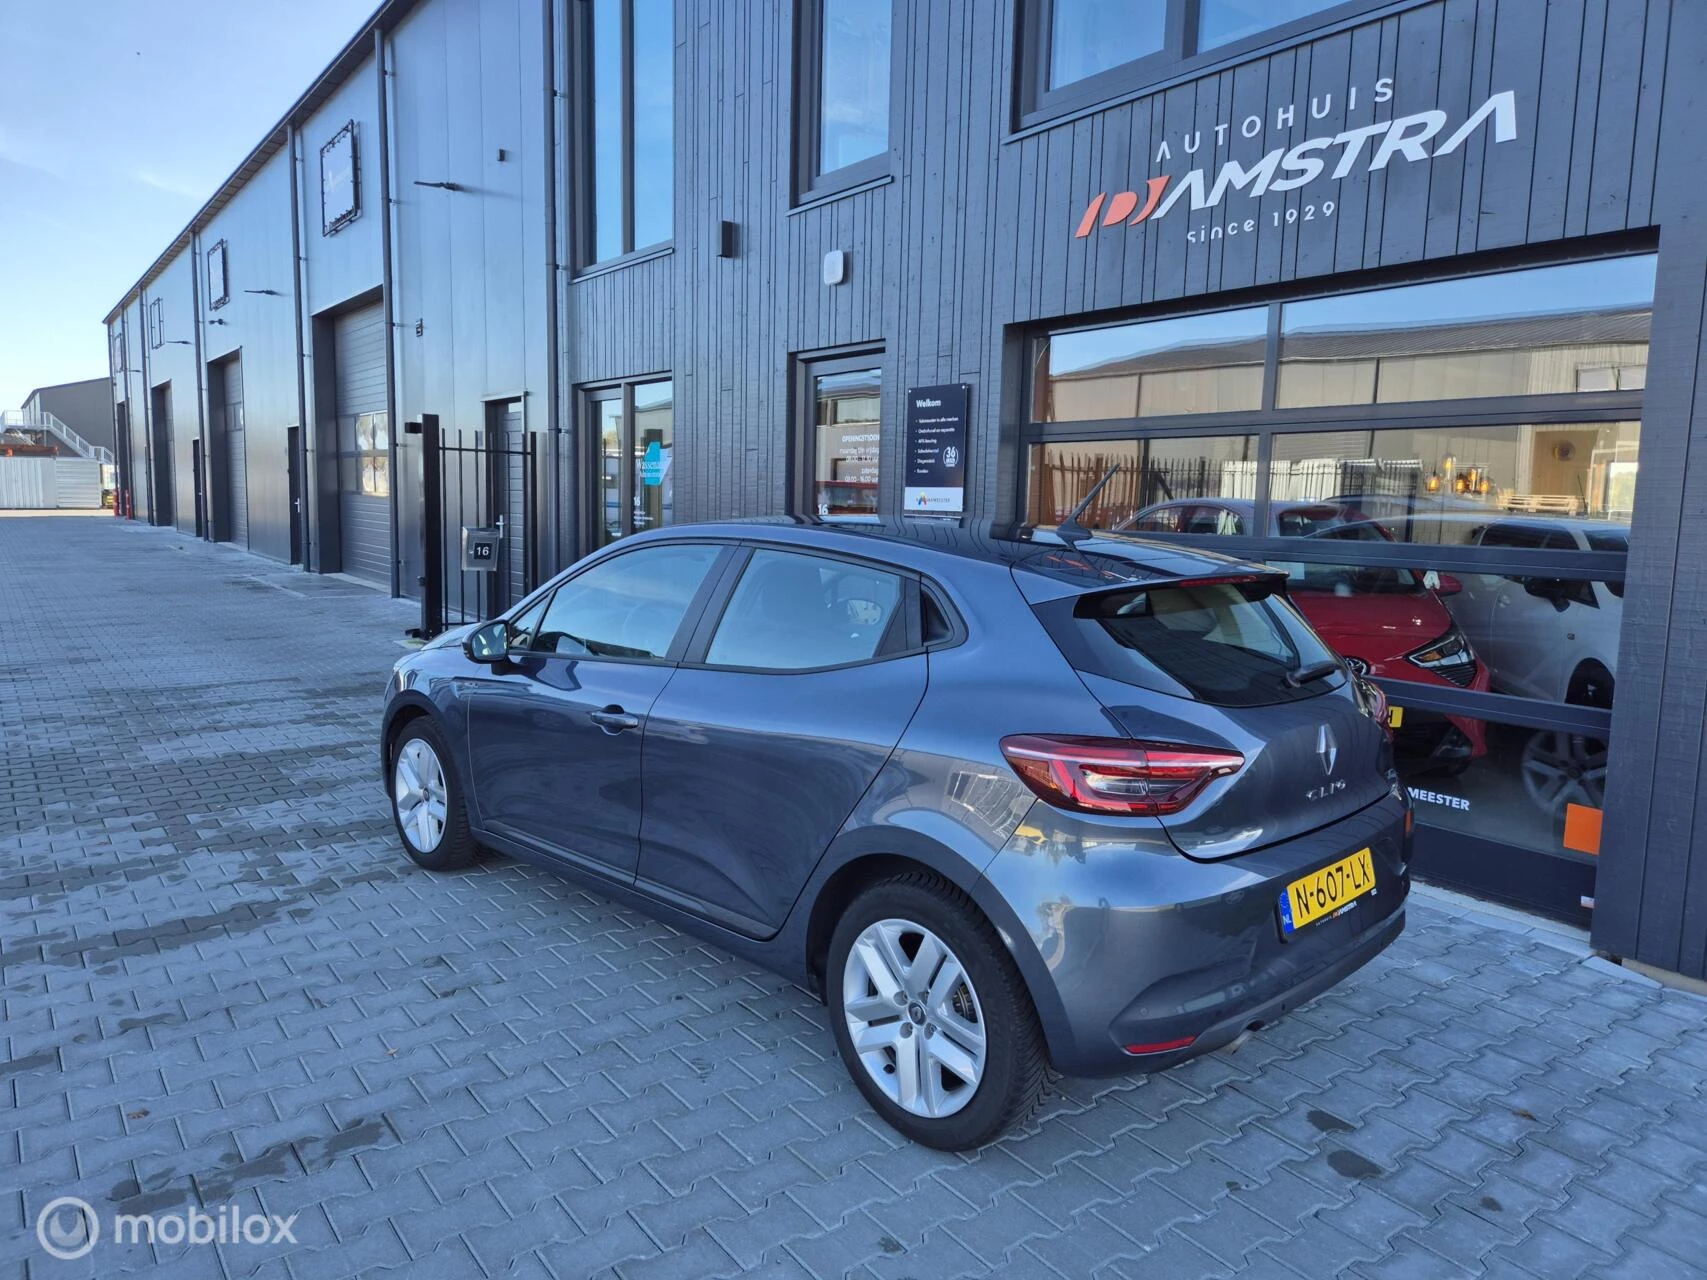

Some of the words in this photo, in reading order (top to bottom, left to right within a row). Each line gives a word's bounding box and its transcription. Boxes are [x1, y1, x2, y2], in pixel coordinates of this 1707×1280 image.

[1155, 77, 1393, 162] AUTOHUIS
[1186, 217, 1255, 243] since
[1272, 200, 1335, 228] 1929
[916, 398, 942, 408] Welkom
[945, 446, 956, 458] 36
[817, 503, 829, 516] 16
[476, 546, 490, 556] 16
[1408, 786, 1471, 812] MEESTER
[1295, 853, 1371, 919] N-607-LX
